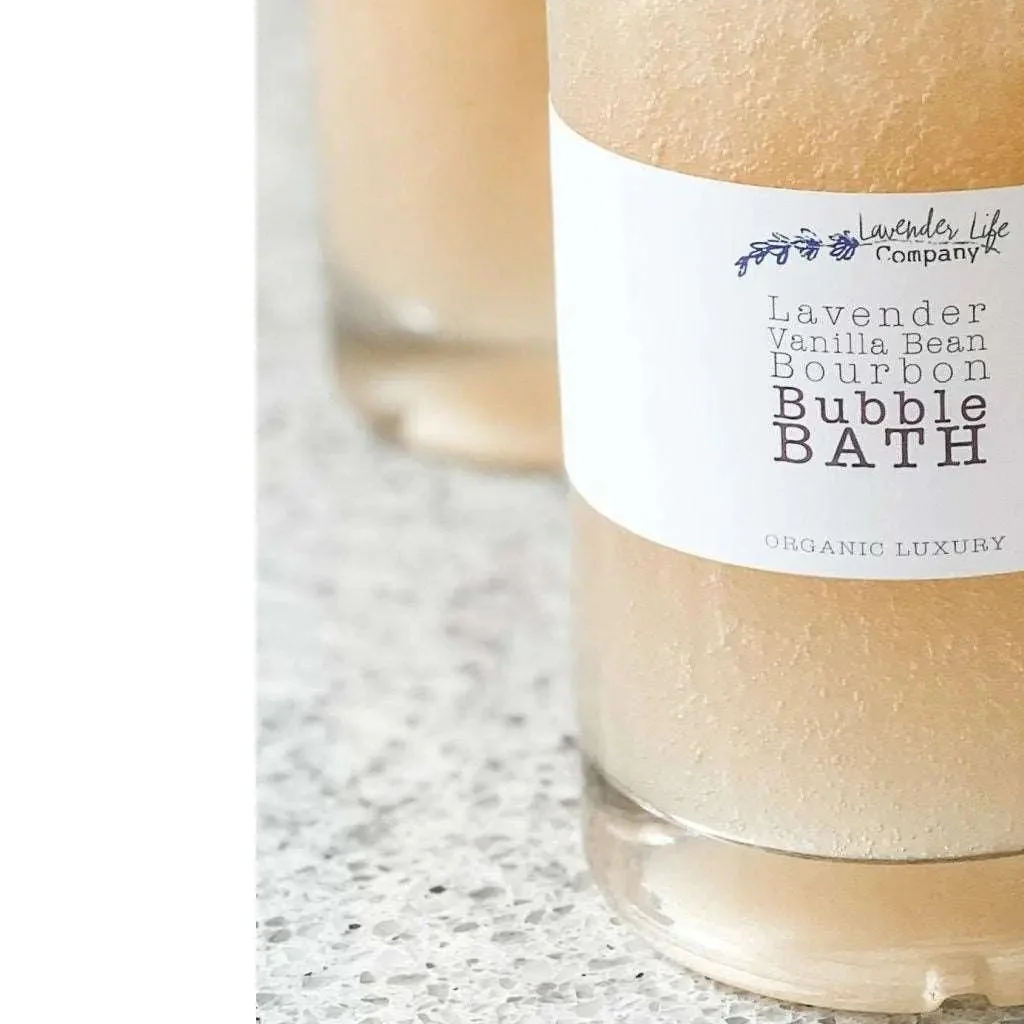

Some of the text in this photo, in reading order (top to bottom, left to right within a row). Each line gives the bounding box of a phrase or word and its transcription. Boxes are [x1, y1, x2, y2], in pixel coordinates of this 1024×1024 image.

[858, 207, 1010, 254] Lavender Life
[875, 243, 980, 267] Company
[768, 295, 987, 327] Lavender
[768, 326, 988, 355] Vanilla Bean
[770, 351, 990, 385] Bourbon
[773, 385, 987, 425] Bubble
[773, 421, 987, 468] BATH
[764, 533, 1007, 557] ORGANIC LUXURY
